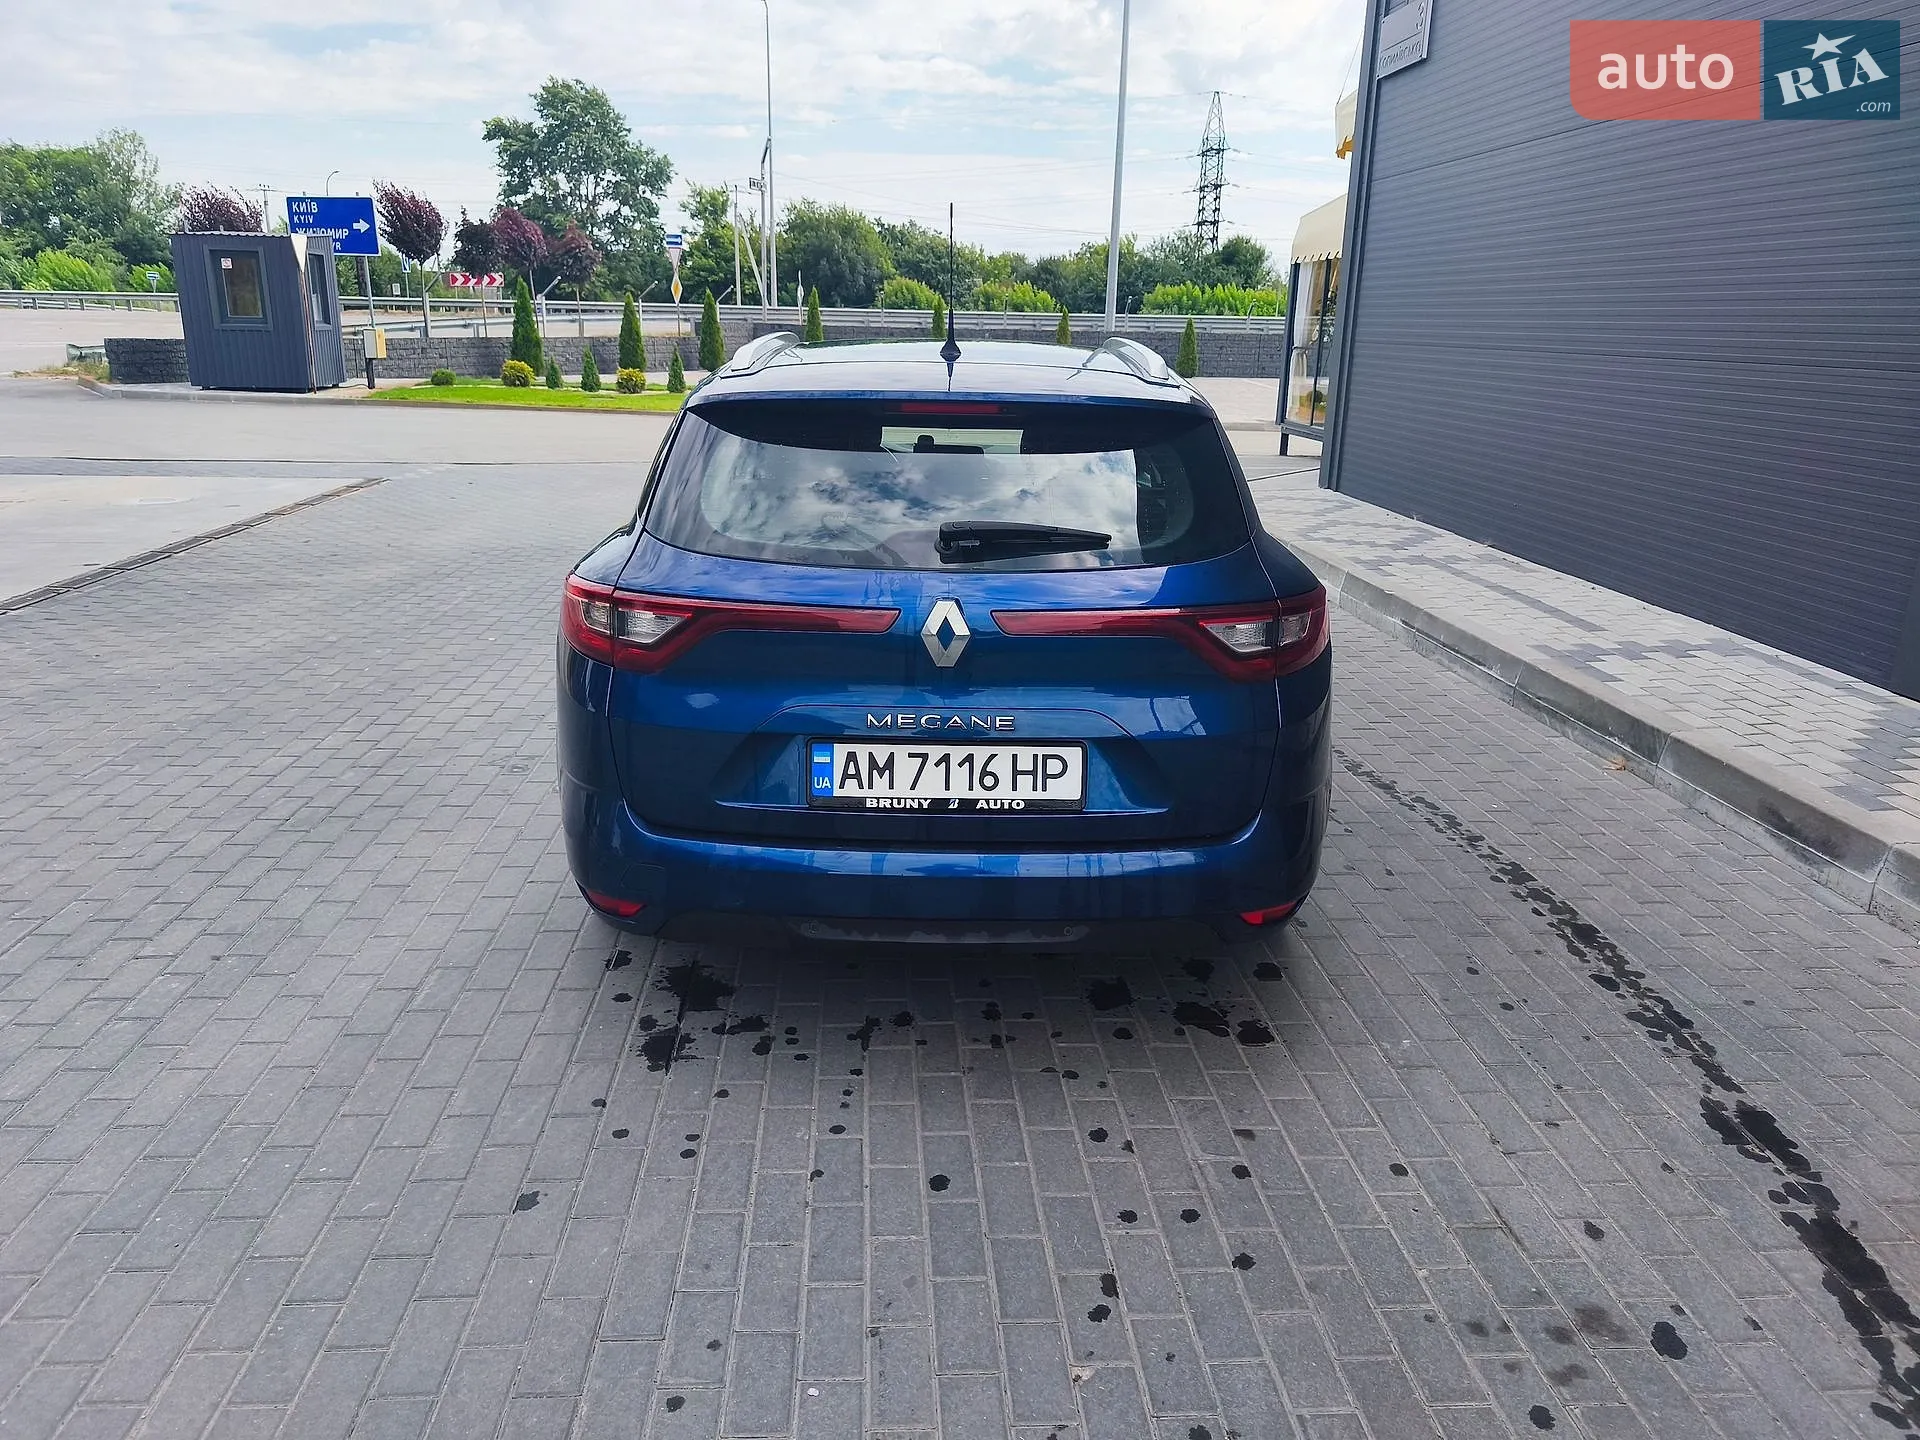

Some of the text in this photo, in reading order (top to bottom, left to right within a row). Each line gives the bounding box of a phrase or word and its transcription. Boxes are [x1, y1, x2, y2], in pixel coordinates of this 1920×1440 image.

[292, 199, 319, 213] КИЇВ
[293, 214, 314, 224] KYIV
[866, 713, 1015, 730] MEGANE
[814, 751, 1069, 792] UA AM 7116 HP
[865, 798, 932, 809] BRUNY
[975, 799, 1026, 810] AUTO
